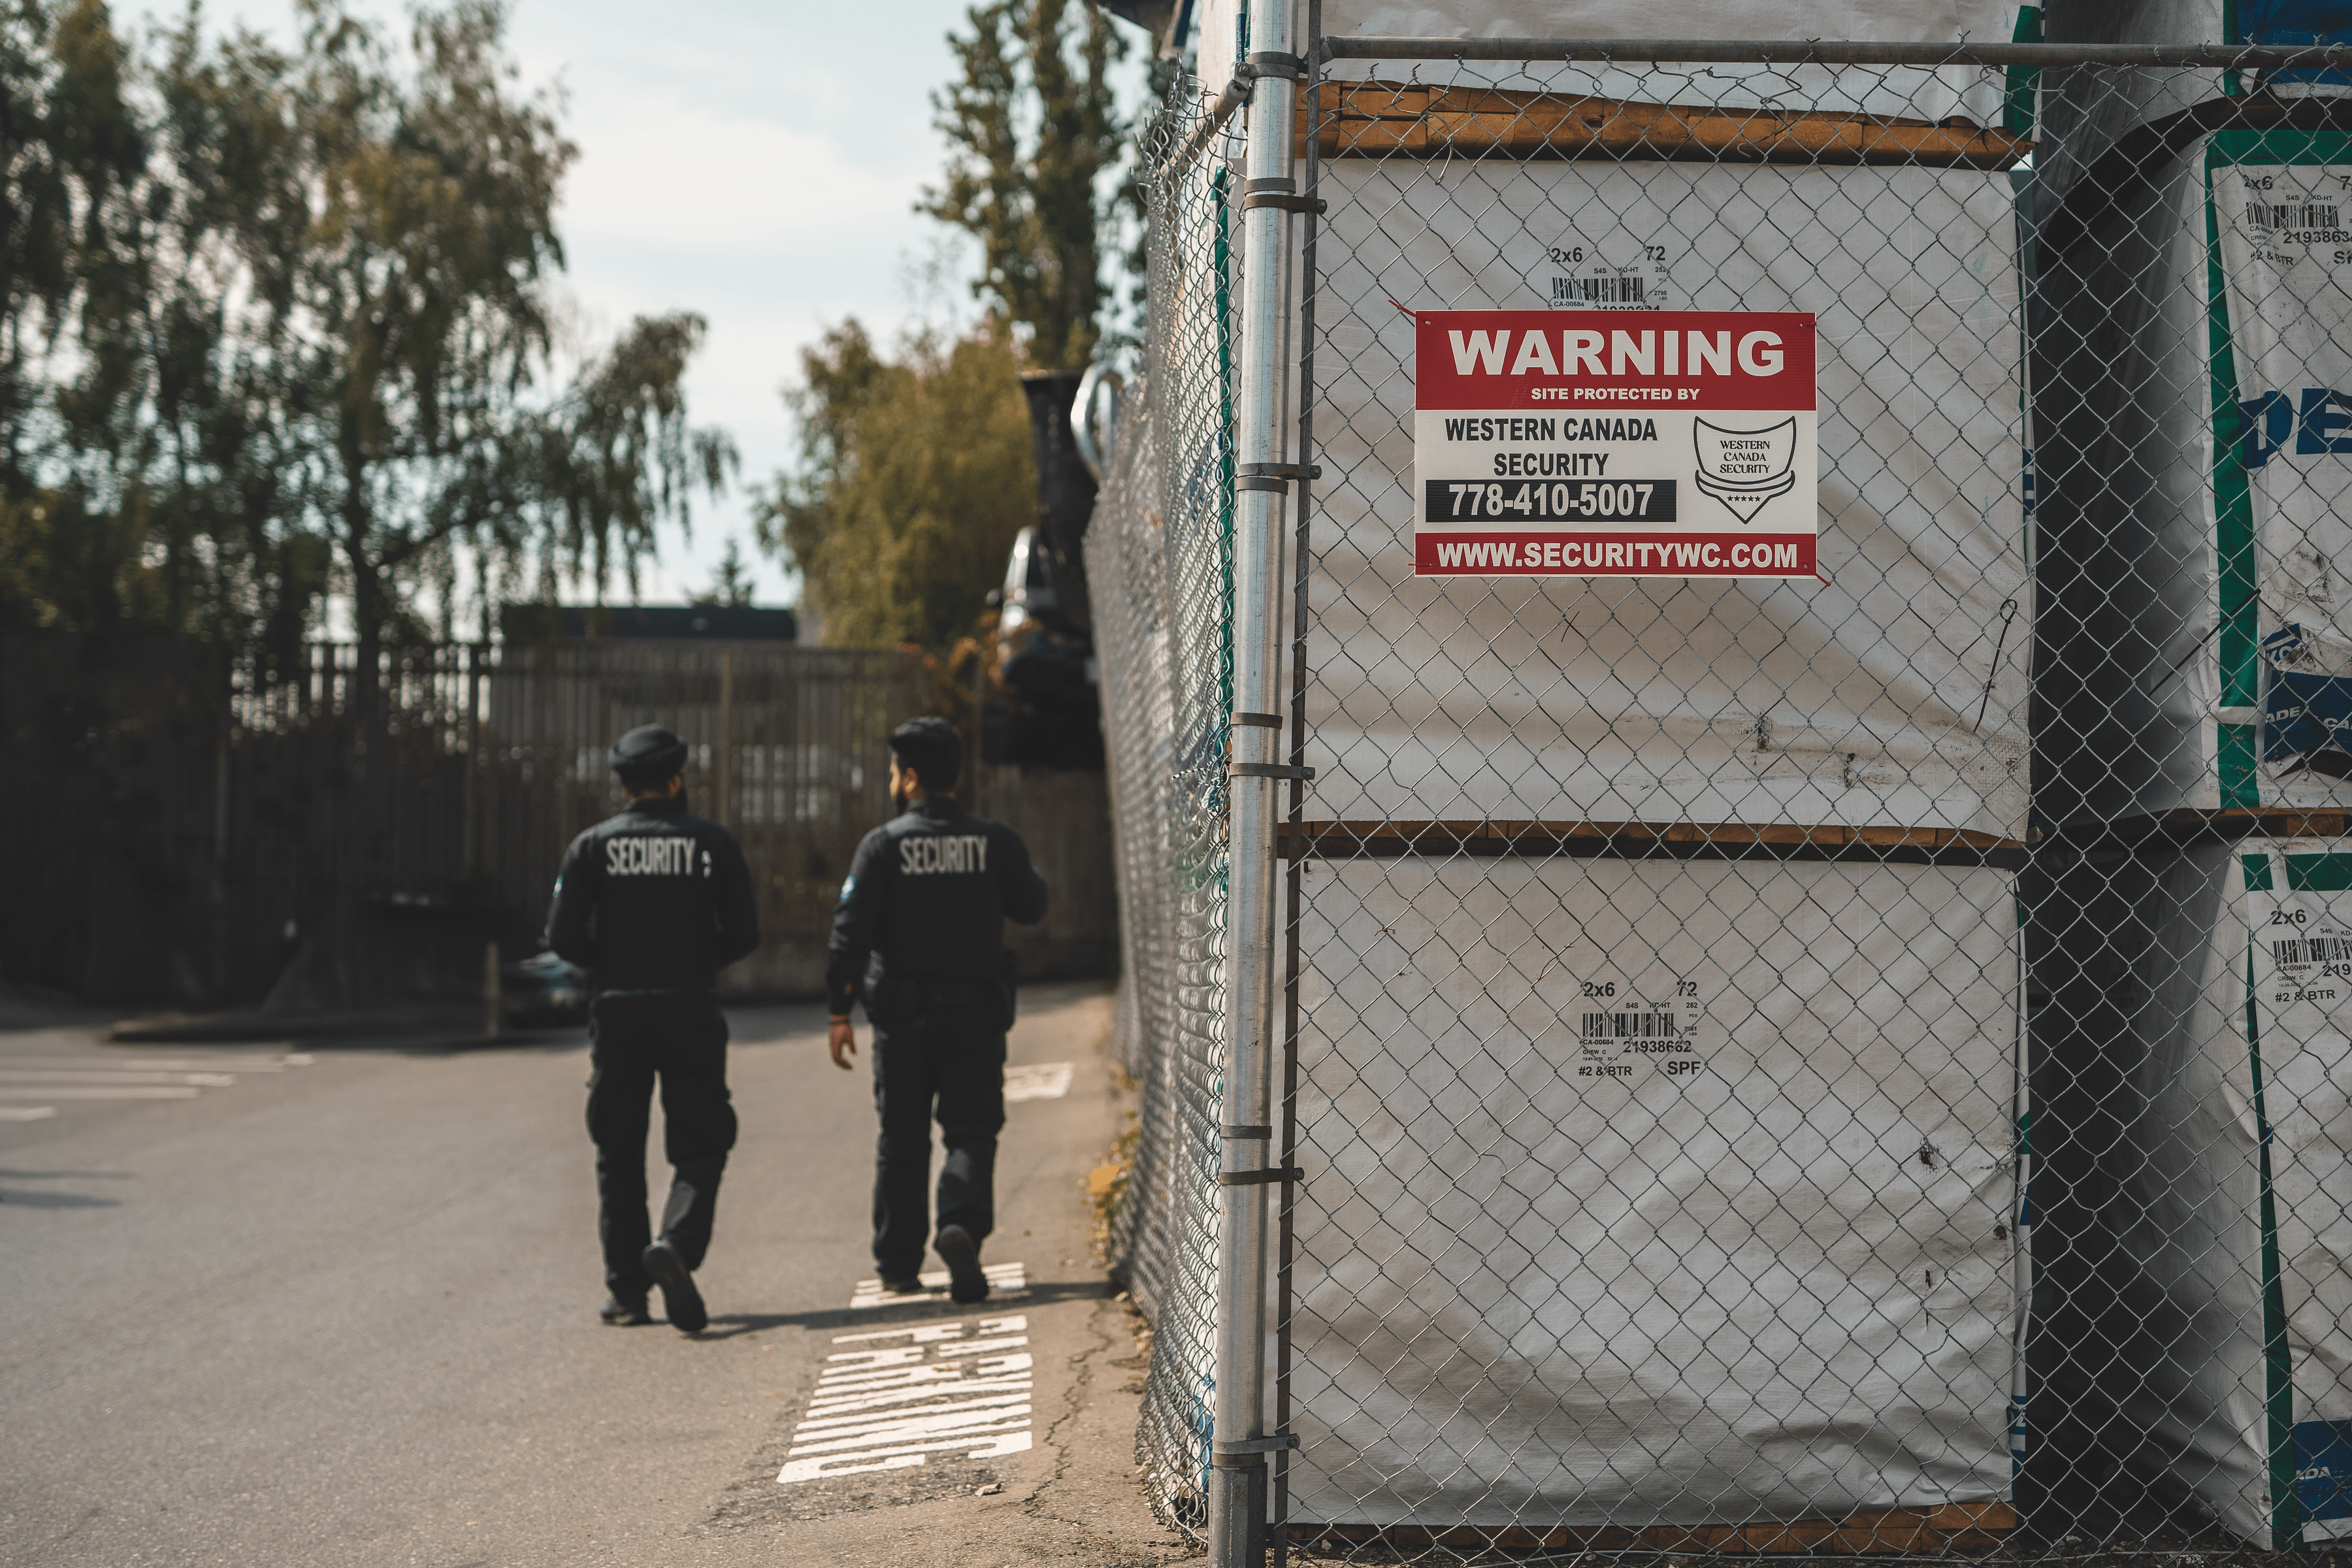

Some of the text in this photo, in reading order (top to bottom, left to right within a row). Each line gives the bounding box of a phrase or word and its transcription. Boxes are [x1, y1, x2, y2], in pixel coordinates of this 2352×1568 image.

[2340, 175, 2352, 191] 7
[2283, 231, 2352, 244] 2193863
[1550, 246, 1583, 263] 2x6
[1645, 245, 1666, 261] 72
[2266, 251, 2274, 260] &
[2274, 253, 2294, 266] BTR
[1448, 329, 1784, 377] WARNING
[1531, 387, 1701, 400] SITE PROTECTED BY
[1445, 417, 1658, 442] WESTERN CANADA
[1720, 440, 1771, 449] WESTERN
[1493, 452, 1610, 477] SECURITY
[1723, 451, 1767, 462] CANADA
[1719, 463, 1771, 474] SECURITY
[1448, 483, 1654, 516] 778-410-5007
[1436, 542, 1797, 568] WWW.SECURITYWC.COM
[605, 836, 697, 876] SECURITY
[899, 834, 988, 875] SECURITY
[2270, 909, 2306, 925] 2x6
[1583, 981, 1615, 997] 2x6
[1676, 981, 1697, 997] 72
[2275, 989, 2336, 1003] #2 & BTR
[1622, 1039, 1692, 1053] 21938662
[1578, 1066, 1633, 1076] #2 & BTR
[1667, 1060, 1701, 1075] SPF
